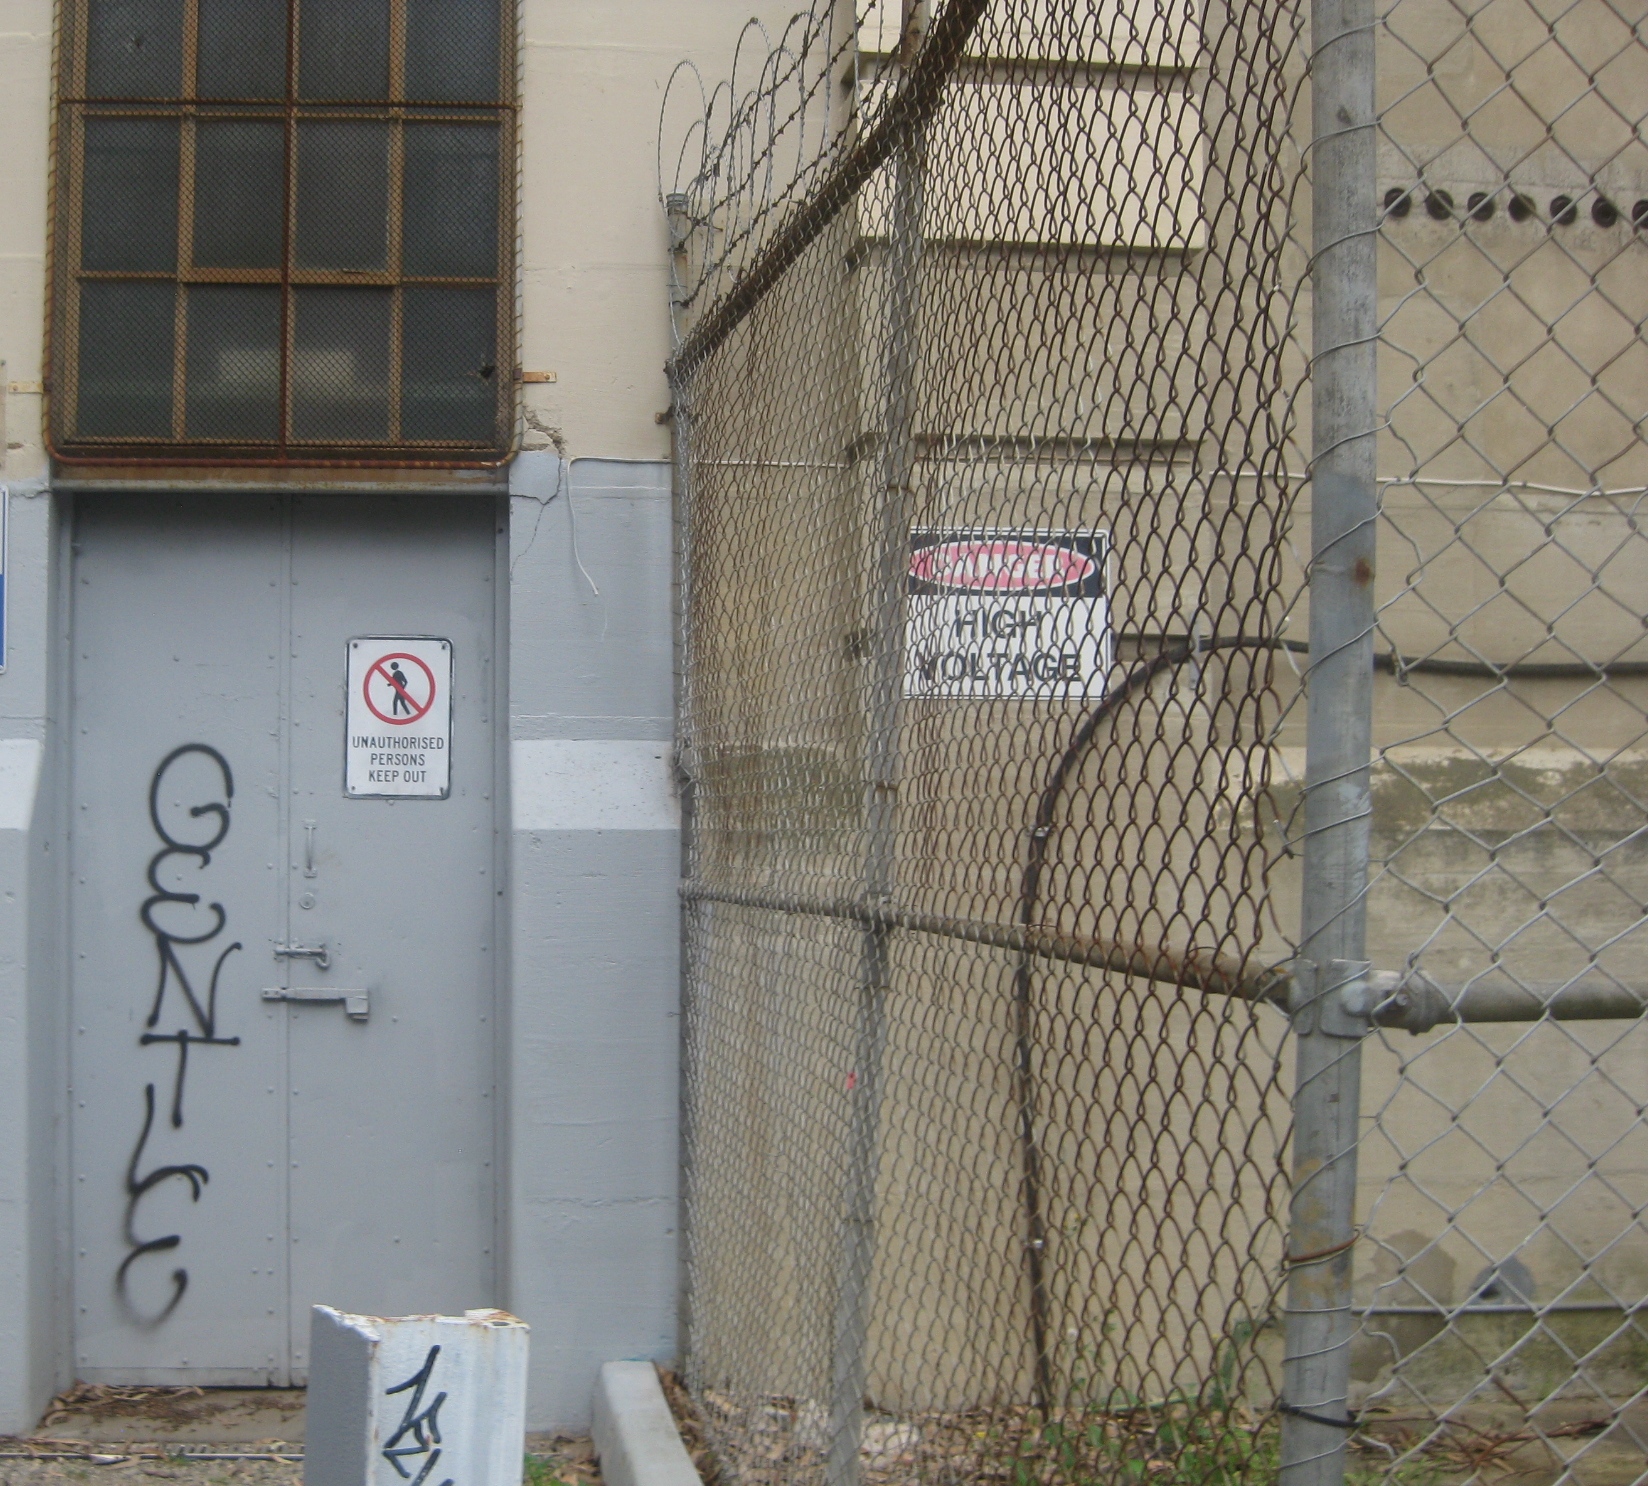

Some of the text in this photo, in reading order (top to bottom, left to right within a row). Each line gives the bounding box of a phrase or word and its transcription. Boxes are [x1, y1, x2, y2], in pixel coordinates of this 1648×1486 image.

[956, 609, 1042, 639] HIGH
[918, 652, 1082, 682] VOLTAGE
[352, 736, 445, 750] UNAUTHORISED
[370, 753, 426, 766] PERSONS
[368, 769, 427, 783] KEEP OUT
